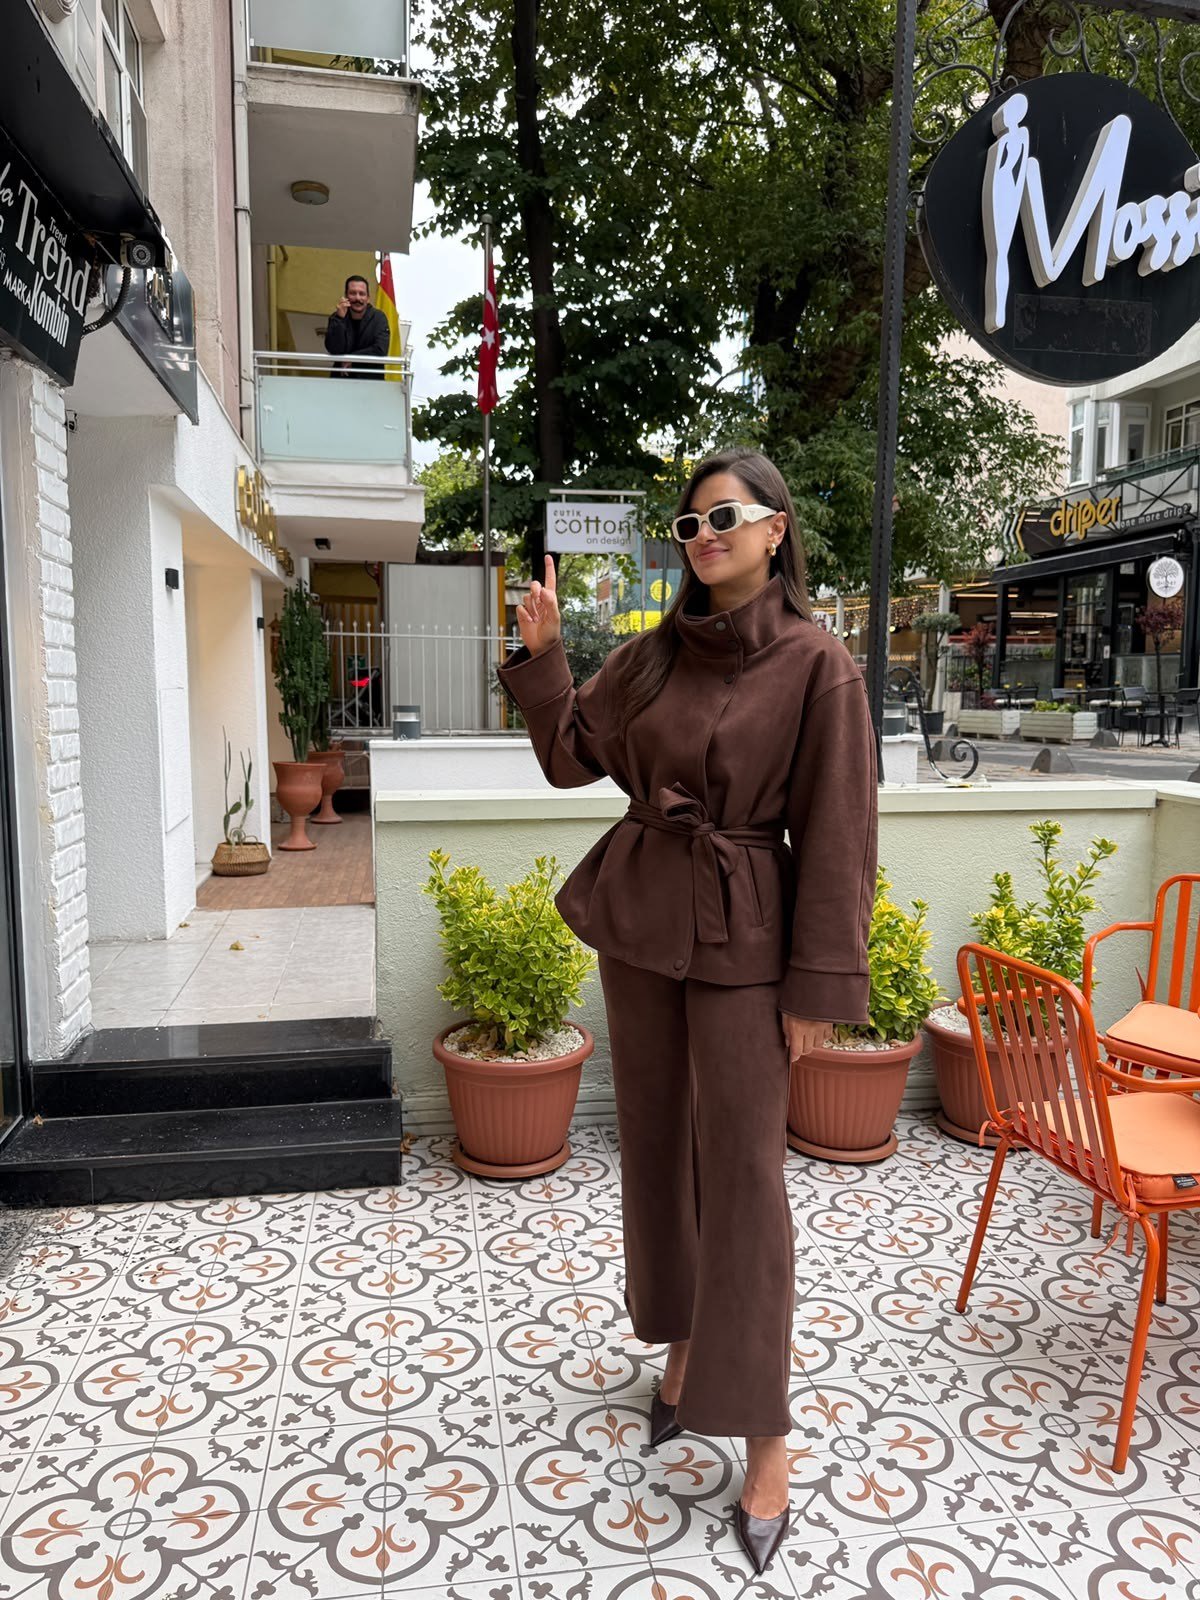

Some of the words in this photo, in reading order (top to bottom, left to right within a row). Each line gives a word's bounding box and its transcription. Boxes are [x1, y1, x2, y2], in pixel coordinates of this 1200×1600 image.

[15, 179, 91, 316] Trend
[49, 216, 68, 248] Trend
[3, 268, 32, 310] MARKA
[29, 271, 70, 348] Kombin
[1120, 518, 1136, 529] one
[1138, 512, 1161, 525] more
[1163, 503, 1192, 519] drip?
[586, 537, 598, 545] on
[600, 536, 631, 546] design
